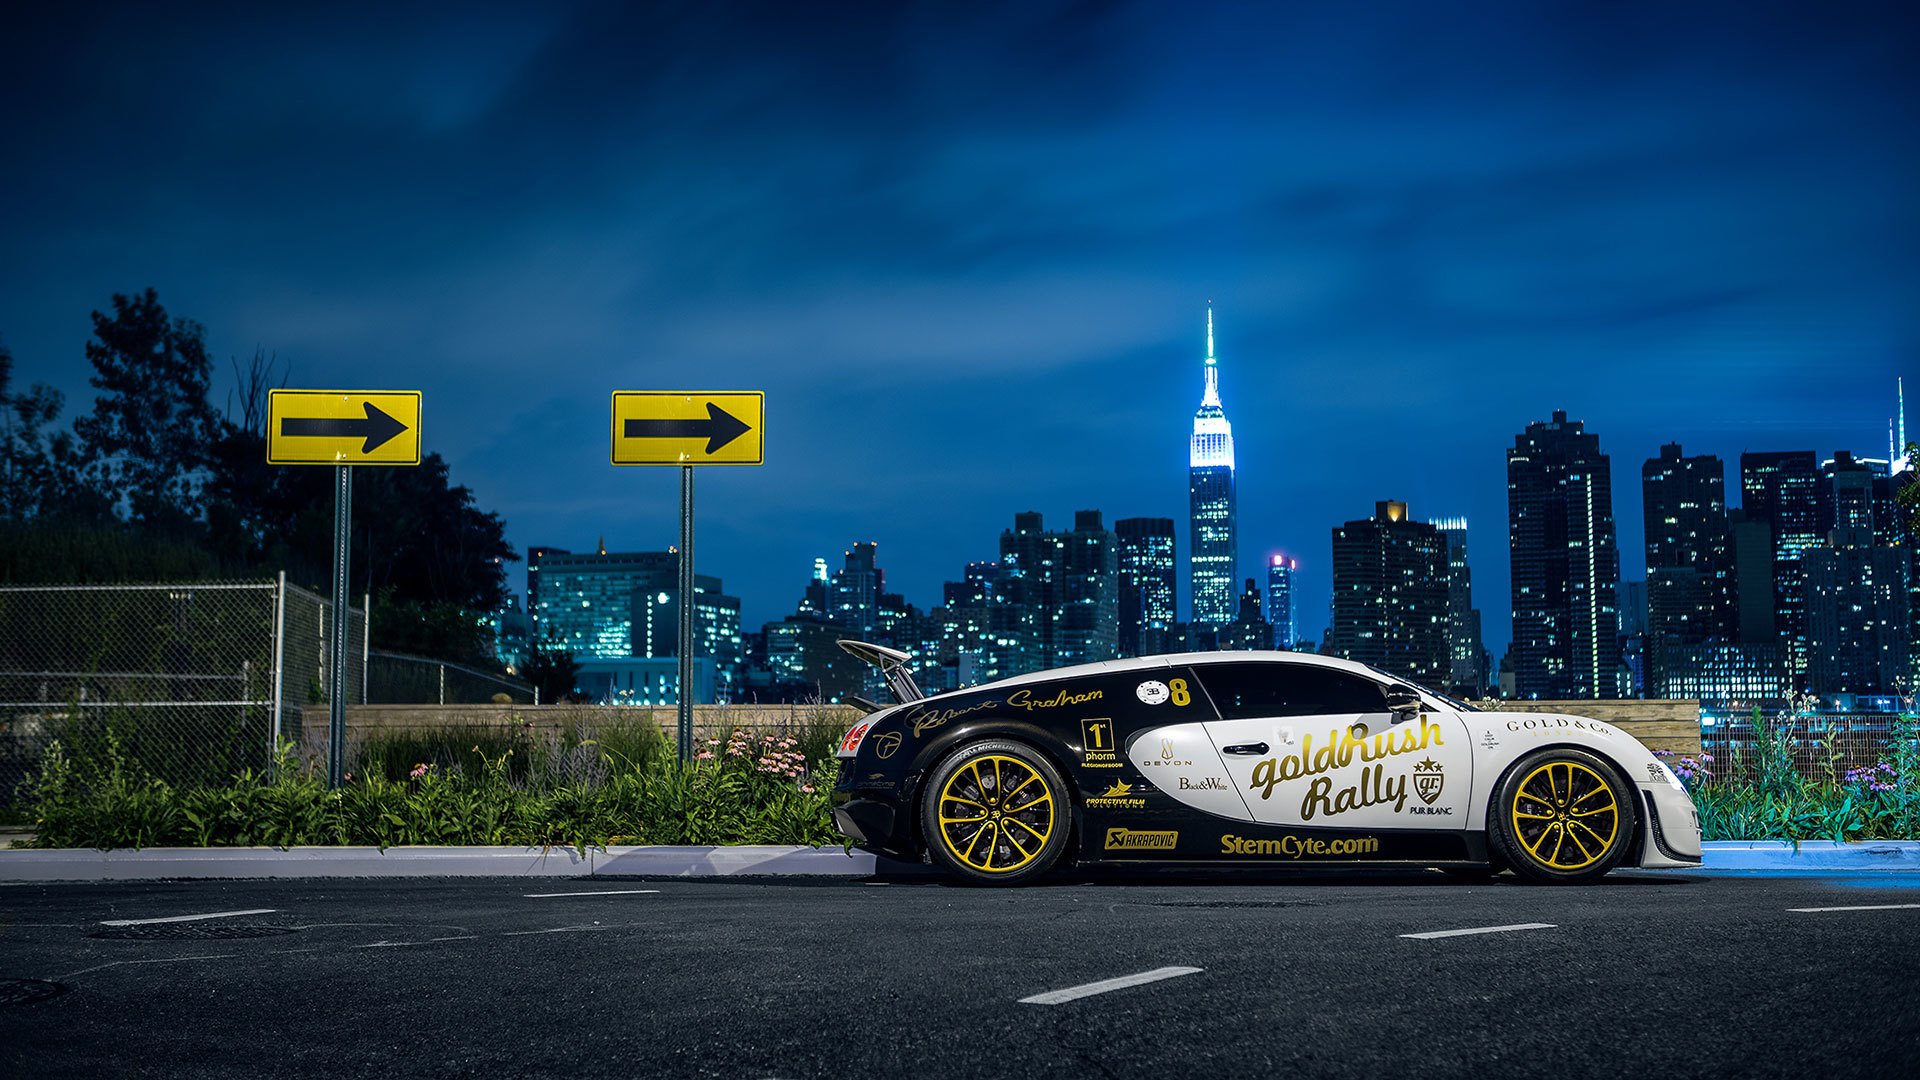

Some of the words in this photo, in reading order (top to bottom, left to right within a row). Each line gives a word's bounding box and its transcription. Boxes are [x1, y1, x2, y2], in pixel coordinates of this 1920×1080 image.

[1007, 690, 1104, 711] Graham
[1168, 678, 1191, 707] 8
[1085, 752, 1116, 762] phorm
[1249, 714, 1445, 800] goldRush
[1301, 764, 1408, 821] Rally
[1410, 806, 1426, 815] PUR
[1427, 806, 1453, 815] BLANC
[1221, 834, 1379, 859] StemCyte.com
